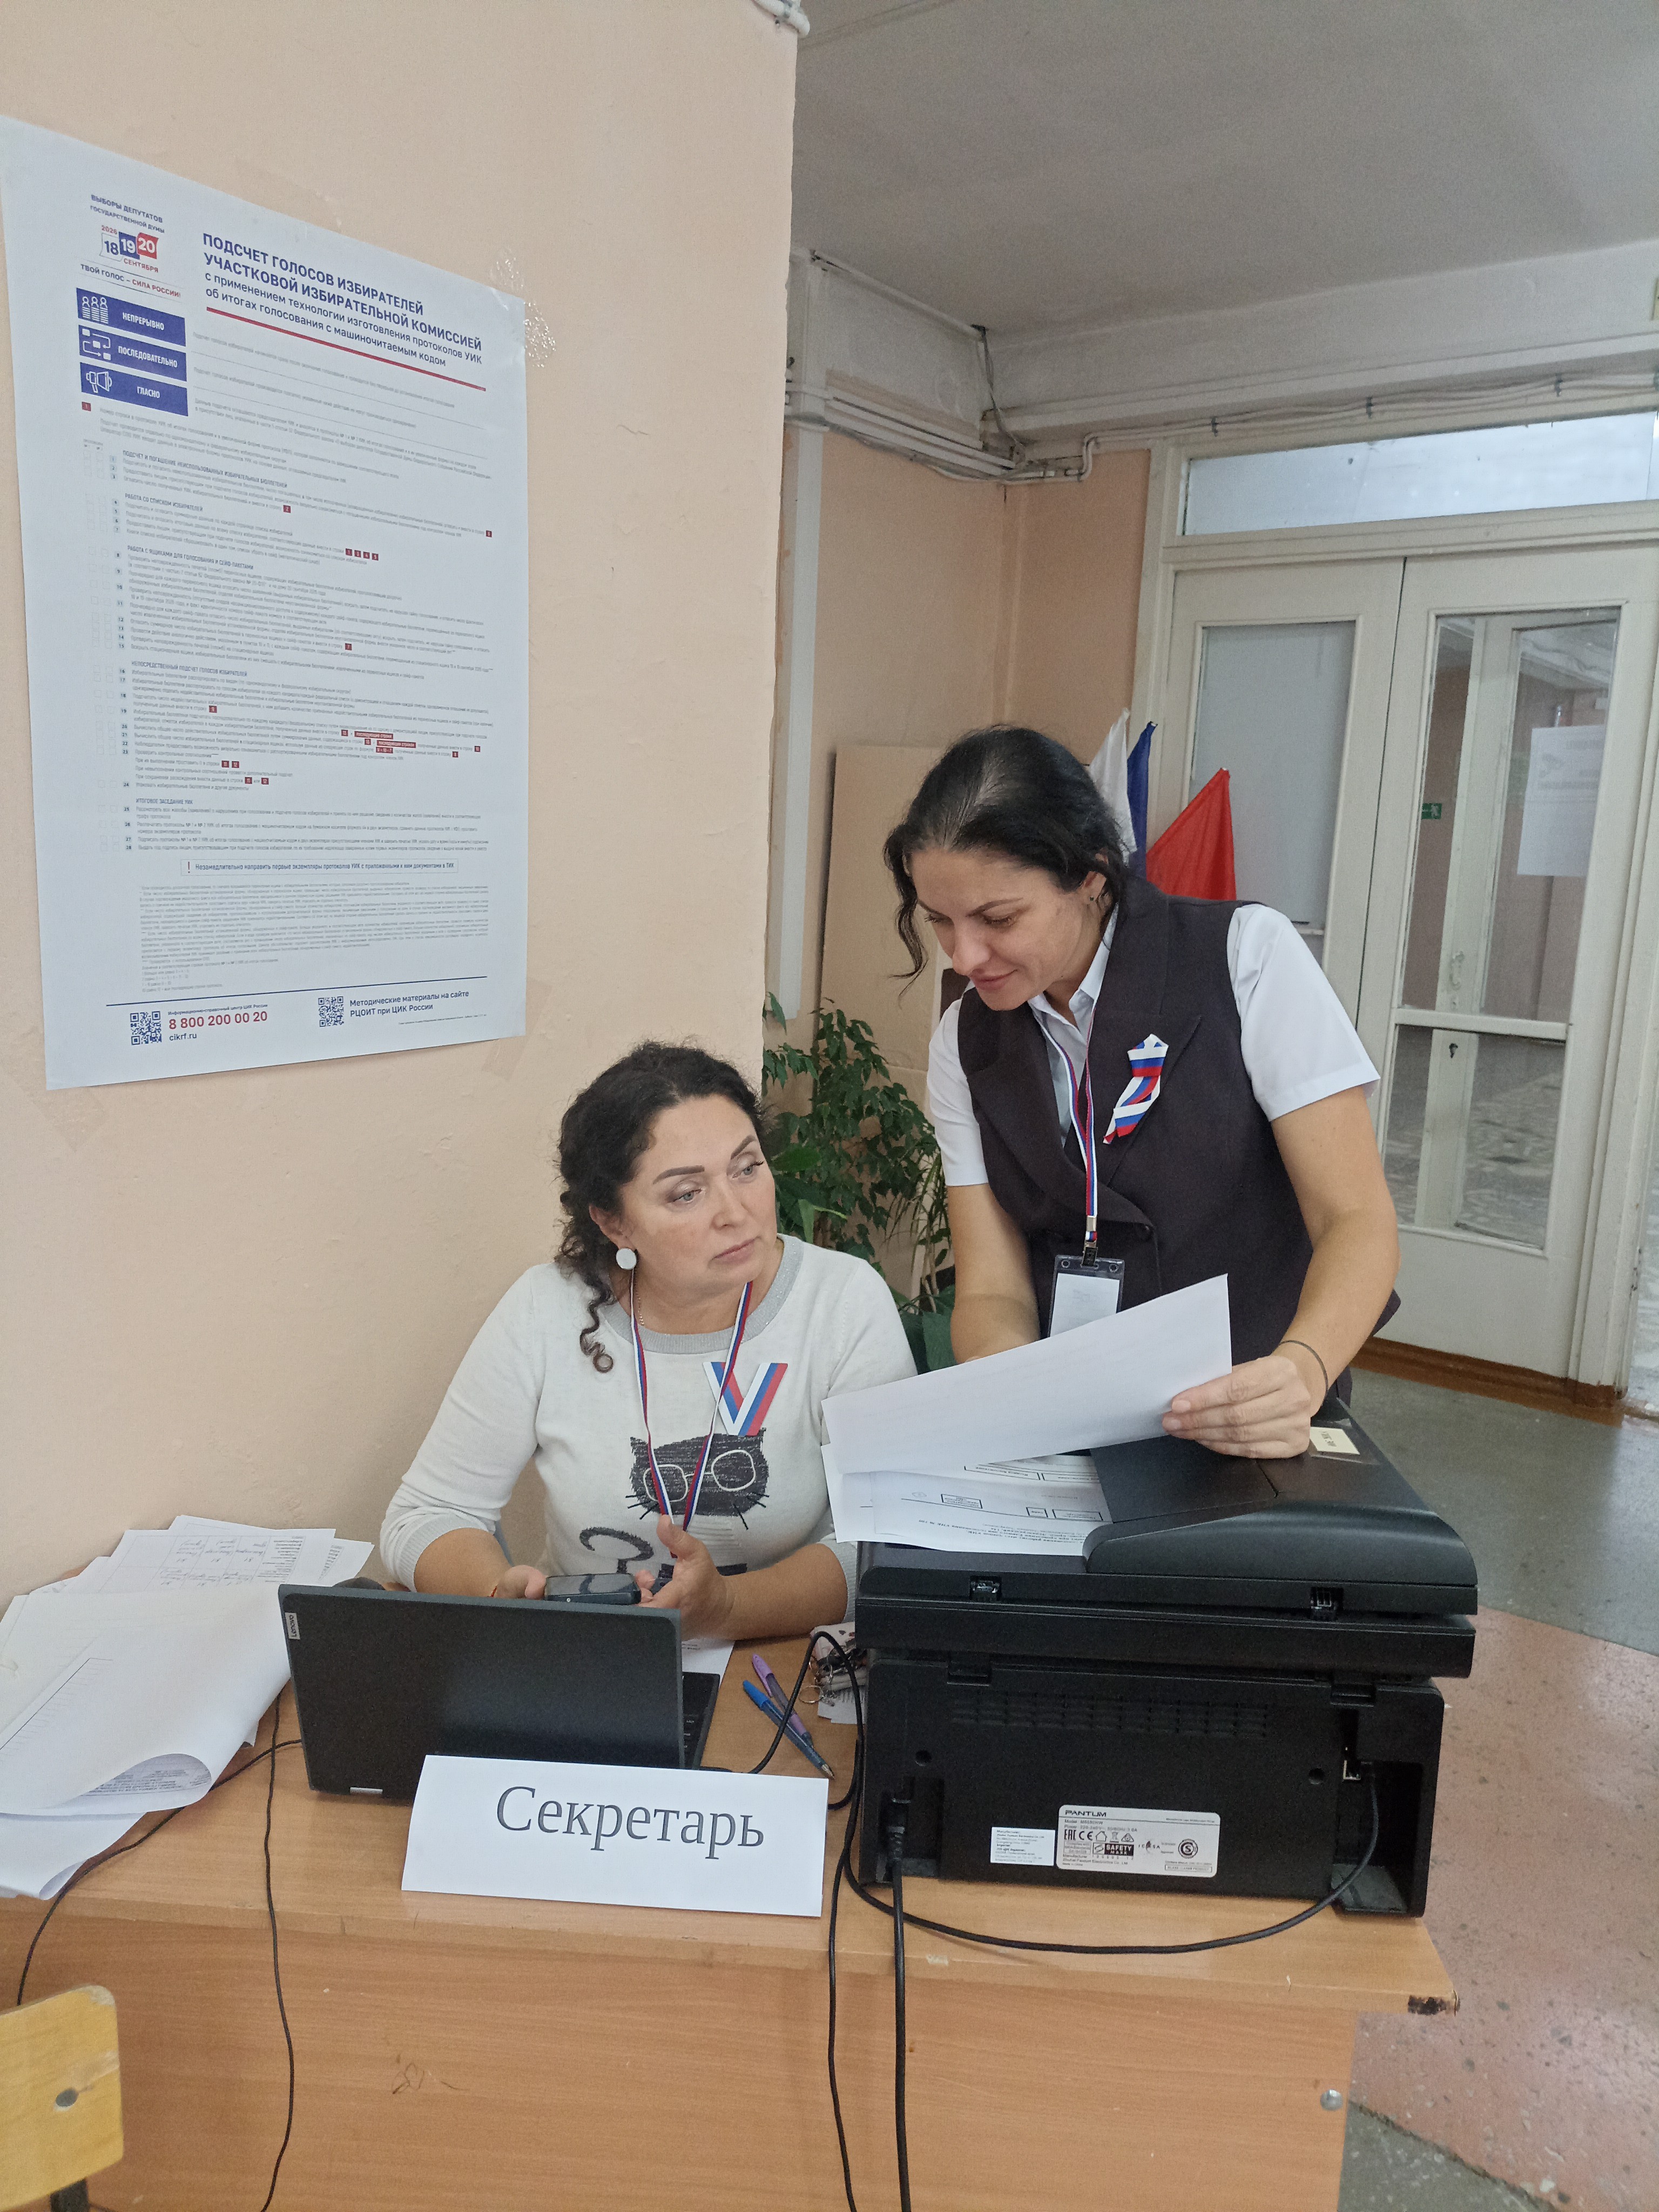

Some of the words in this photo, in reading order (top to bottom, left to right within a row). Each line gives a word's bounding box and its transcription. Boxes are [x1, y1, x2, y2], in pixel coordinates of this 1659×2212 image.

[90, 205, 146, 227] ГОСУДАРСТВЕННОЙ
[148, 224, 164, 233] ДУМЫ
[91, 194, 122, 209] ВЫБОРЫ
[124, 205, 163, 222] ДЕПУТАТОВ
[102, 225, 117, 234] 2026
[104, 240, 119, 255] 18
[121, 239, 134, 253] 19
[138, 237, 155, 253] 20
[124, 258, 158, 273] СЕНТЯБРЯ
[204, 233, 268, 264] ПОДСЧЕТ
[273, 256, 334, 286] ГОЛОСОВ
[338, 277, 423, 315] ИЗБИРАТЕЛЕЙ
[81, 264, 99, 274] ТВОЙ
[102, 271, 124, 281] ГОЛОС
[132, 279, 150, 288] СИЛА
[152, 285, 180, 297] РОССИИ!
[204, 253, 298, 292] УЧАСТКОВОЙ
[302, 286, 408, 327] ИЗБИРАТЕЛЬНОЙ
[412, 320, 481, 350] КОМИССИЕЙ
[123, 312, 164, 331] НЕПРЕРЫВНО
[205, 273, 211, 281] с
[214, 275, 285, 304] применением
[289, 298, 345, 321] технологии
[347, 317, 410, 342] изготовления
[413, 337, 462, 358] протоколов
[465, 352, 482, 364] УИК
[206, 288, 218, 298] об
[222, 294, 257, 310] итогах
[260, 305, 323, 329] голосования
[335, 327, 416, 358] машиночитаемым
[420, 352, 446, 366] кодом
[118, 346, 178, 368] ПОСЛЕДОВАТЕЛЬНО
[137, 387, 160, 399] ГЛАСНО
[350, 996, 401, 1007] Методические
[350, 1008, 375, 1017] РЦОИТ
[392, 1005, 407, 1014] ЦИК
[169, 1019, 176, 1029] 8
[180, 1016, 204, 1028] 800
[208, 1014, 231, 1026] 200
[235, 1013, 249, 1023] 00
[253, 1011, 267, 1022] 20
[289, 1615, 297, 1637] Lenovo
[497, 1785, 764, 1859] Секретарь
